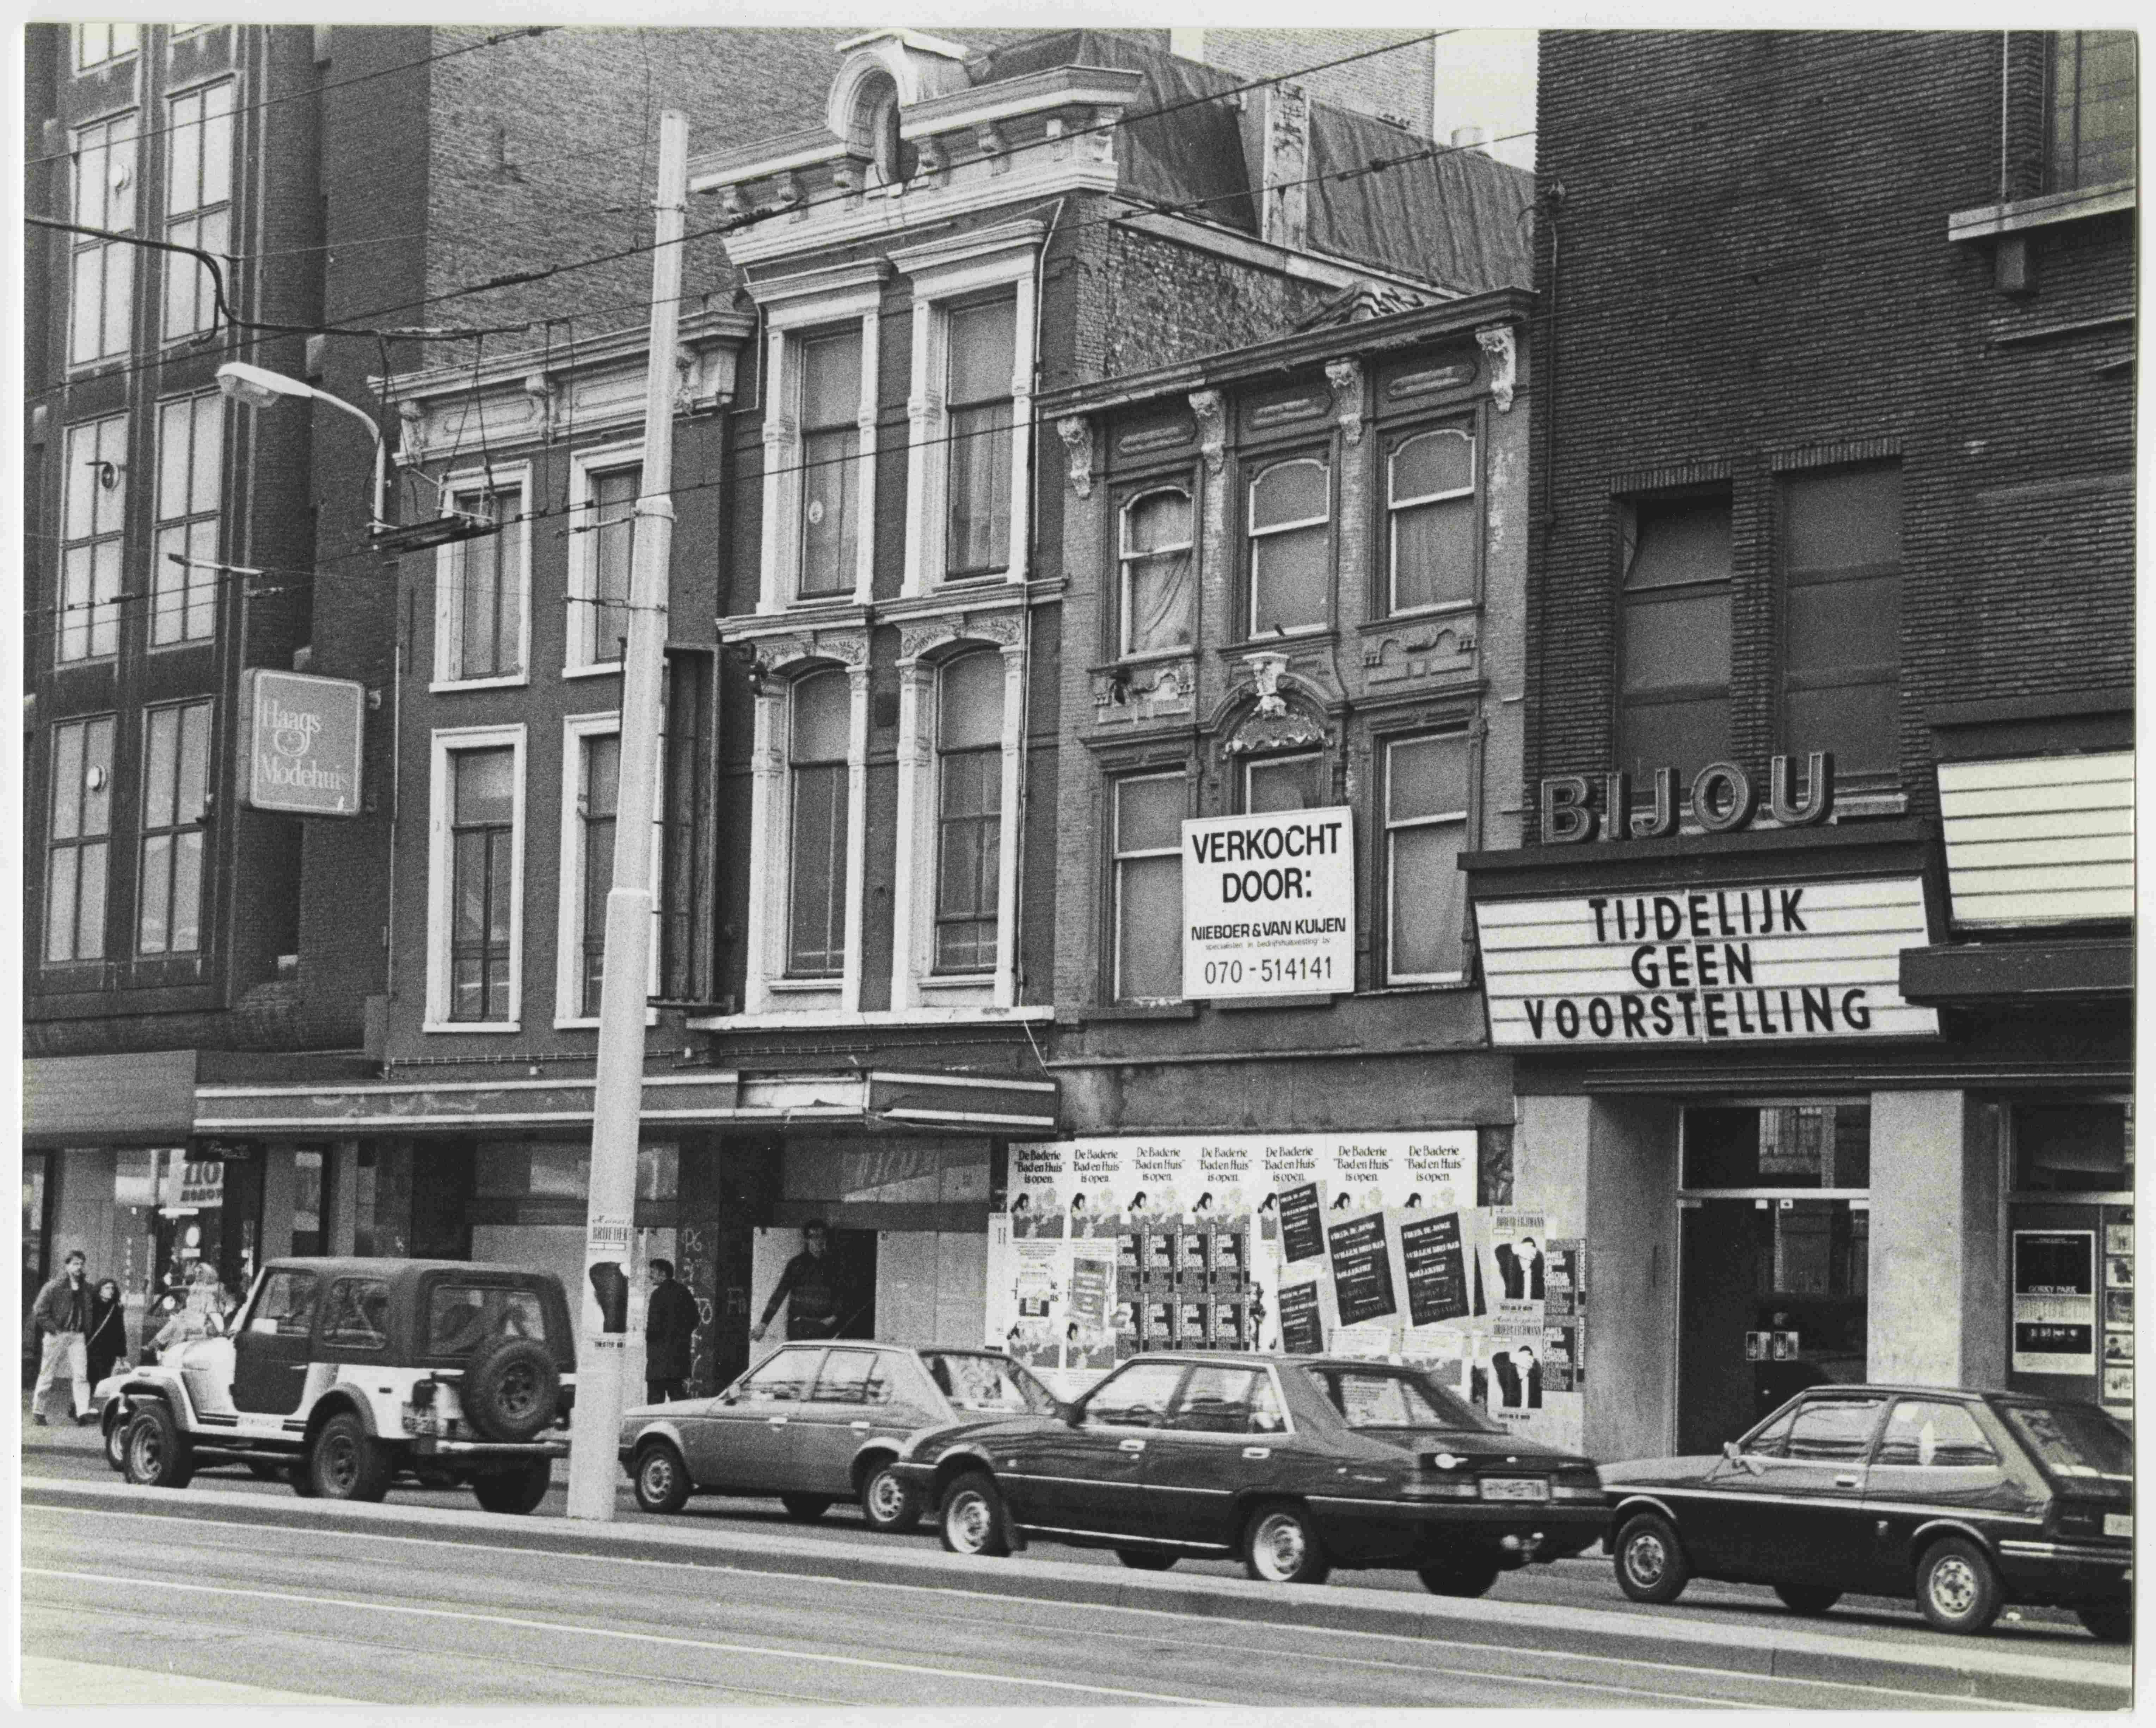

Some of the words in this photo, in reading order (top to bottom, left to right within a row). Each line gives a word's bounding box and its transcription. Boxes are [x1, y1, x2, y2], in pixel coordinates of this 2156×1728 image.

[1540, 751, 1833, 845] BIJOU
[1192, 823, 1342, 863] VERKOCHT
[1222, 868, 1312, 903] DOOR:
[1589, 888, 1807, 942] TIJDELIJK
[1191, 924, 1250, 941] NIEBOER
[1252, 923, 1261, 936] &
[1263, 921, 1291, 935] VAN
[1296, 918, 1346, 934] KUIJEN
[1632, 942, 1753, 988] GEEN
[1524, 987, 1871, 1039] VOORSTELLING
[1019, 1150, 1029, 1160] De
[1031, 1150, 1061, 1160] Baderie
[1075, 1149, 1086, 1160] De
[1087, 1148, 1118, 1159] Baderie
[1137, 1147, 1148, 1157] De
[1149, 1146, 1180, 1157] Baderie
[1202, 1147, 1212, 1158] De
[1215, 1146, 1247, 1157] Baderie
[1266, 1146, 1278, 1157] De
[1279, 1145, 1313, 1157] Baderie
[1339, 1145, 1350, 1156] De
[1352, 1145, 1387, 1156] Baderie
[1409, 1145, 1421, 1156] De
[1423, 1145, 1459, 1156] Baderie
[1284, 1160, 1294, 1169] en
[1357, 1161, 1367, 1169] en
[1428, 1161, 1439, 1169] en
[1024, 1174, 1031, 1183] is
[1081, 1174, 1087, 1182] is
[1143, 1172, 1149, 1180] is
[1208, 1172, 1214, 1181] is
[1273, 1172, 1280, 1181] is
[1345, 1172, 1352, 1181] is
[1416, 1171, 1423, 1181] is
[2056, 1285, 2077, 1294] PARK
